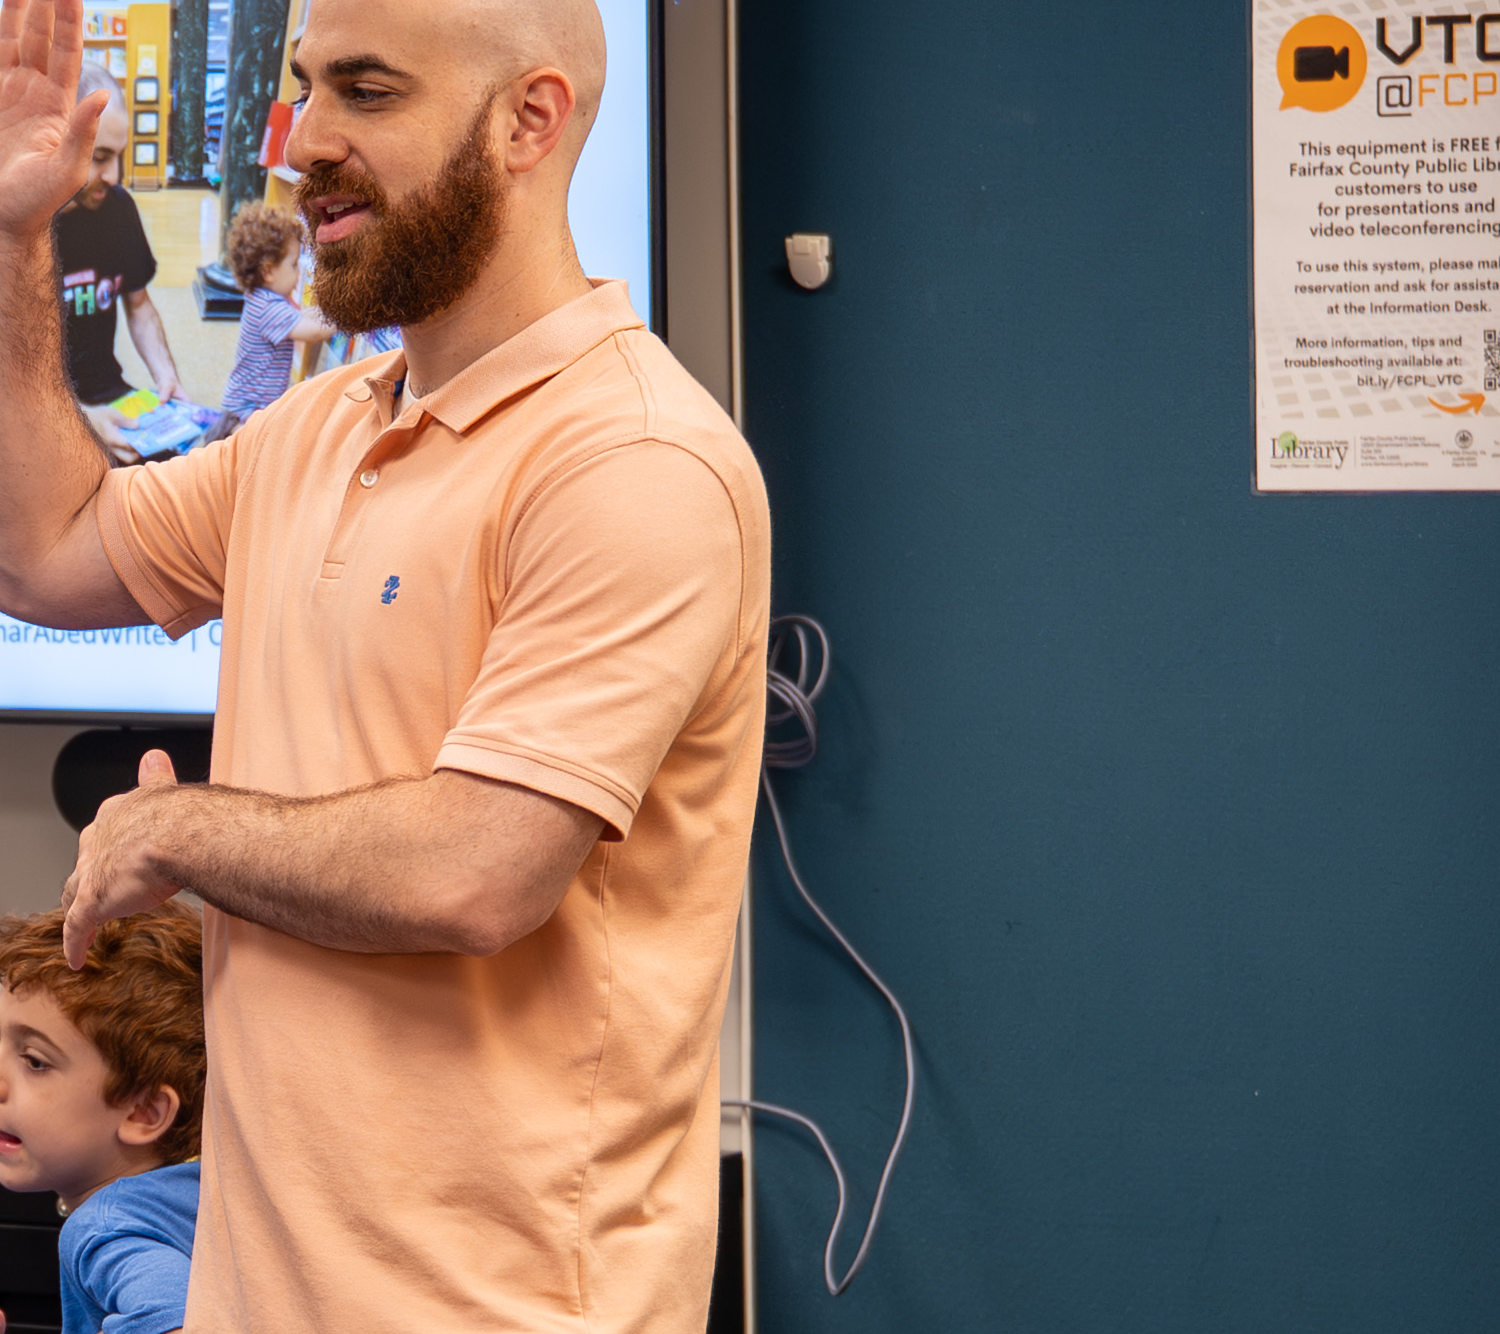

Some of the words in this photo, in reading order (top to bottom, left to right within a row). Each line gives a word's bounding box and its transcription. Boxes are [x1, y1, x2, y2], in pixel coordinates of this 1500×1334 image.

[1299, 142, 1331, 156] This
[1336, 140, 1427, 160] equipment
[1432, 140, 1445, 154] is
[1450, 137, 1490, 152] FREE
[1289, 160, 1344, 177] Fairfax
[1349, 160, 1410, 178] County
[1415, 157, 1467, 174] Public
[1335, 182, 1421, 196] customers
[1427, 181, 1443, 194] to
[1449, 181, 1478, 194] use
[1318, 202, 1340, 217] for
[1345, 200, 1459, 220] presentations
[1464, 198, 1496, 213] and
[1309, 222, 1355, 237] video
[1296, 261, 1313, 273] To
[1316, 262, 1339, 273] use
[1343, 260, 1368, 273] this
[1372, 260, 1425, 275] system,
[1429, 258, 1473, 273] please
[1294, 280, 1371, 295] reservation
[1374, 280, 1399, 293] and
[1403, 279, 1426, 292] ask
[1430, 279, 1450, 292] for
[1327, 302, 1340, 315] at
[1343, 301, 1366, 315] the
[1370, 300, 1450, 314] Information
[1454, 299, 1492, 314] Desk.
[1295, 336, 1328, 349] More
[1331, 336, 1408, 350] information,
[1411, 335, 1435, 351] tips
[1439, 335, 1463, 348] and
[1284, 356, 1383, 370] troubleshooting
[1387, 356, 1443, 368] available
[1446, 356, 1463, 368] at:
[1356, 374, 1463, 390] bit.ly/FCPL_VTC
[1270, 437, 1350, 470] Library
